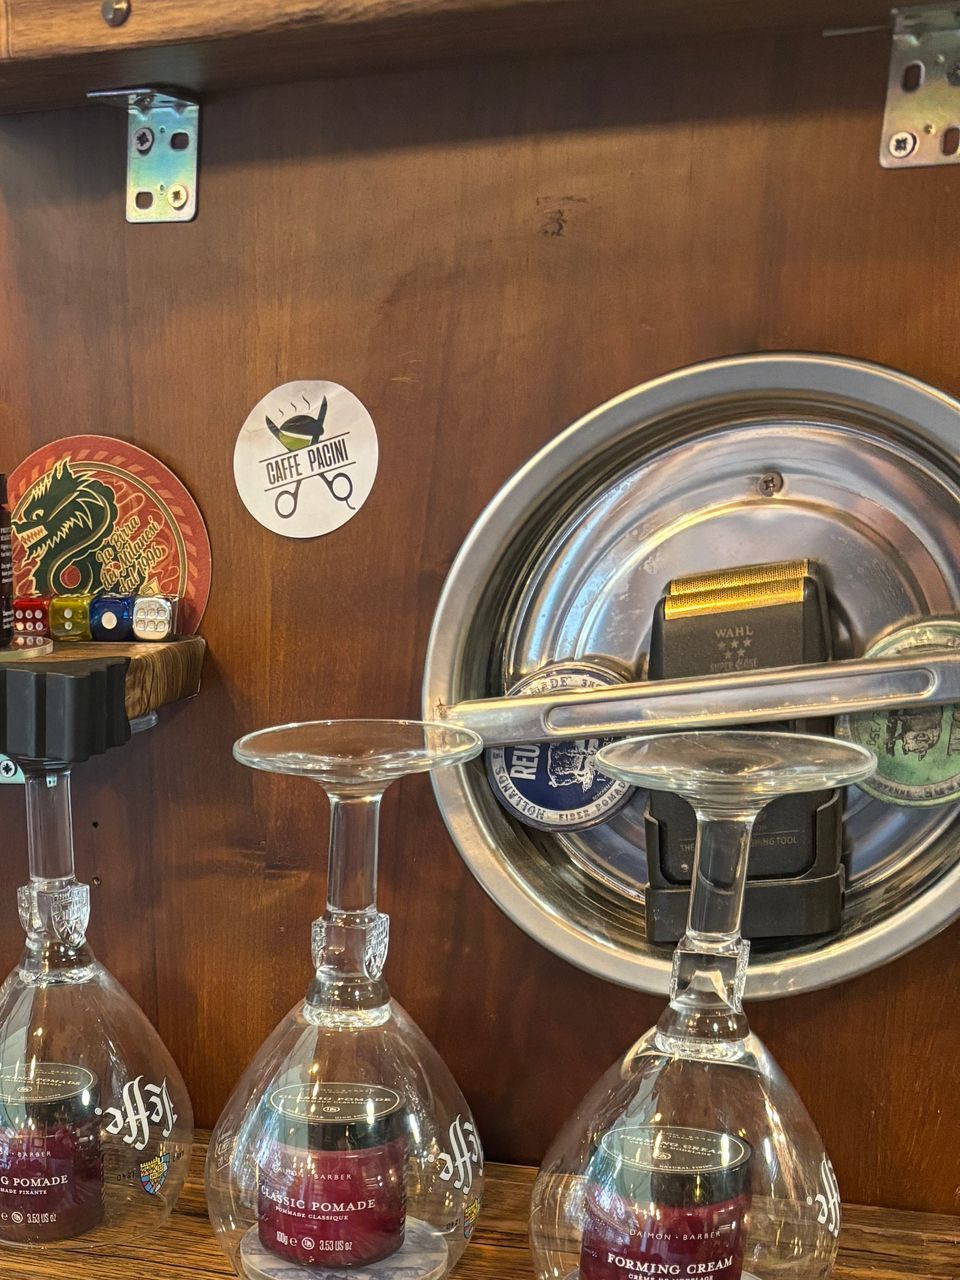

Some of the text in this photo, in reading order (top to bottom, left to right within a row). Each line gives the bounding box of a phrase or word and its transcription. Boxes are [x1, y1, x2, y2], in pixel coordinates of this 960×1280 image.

[266, 438, 349, 485] CAFFE PACINI
[109, 515, 141, 551] Birra
[119, 541, 169, 594] dal 1996
[715, 625, 754, 639] WAHL
[710, 660, 732, 673] SUPER
[495, 766, 547, 822] HOLLANDS
[558, 810, 591, 823] FIBER
[595, 780, 627, 812] POMAD
[16, 1150, 52, 1159] BARBER
[12, 1173, 70, 1188] POMADE
[314, 1173, 353, 1181] BARBER
[18, 1187, 48, 1196] FIXANTE
[260, 1184, 377, 1213] CLASSIC POMADE
[26, 1212, 51, 1224] 3.53 US
[275, 1206, 350, 1222] POMMADE CLASSIQUE
[276, 1230, 346, 1252] 100g 3.53 US
[630, 1229, 722, 1241] DAIMON BARBER
[606, 1252, 734, 1275] FORMING CREAM
